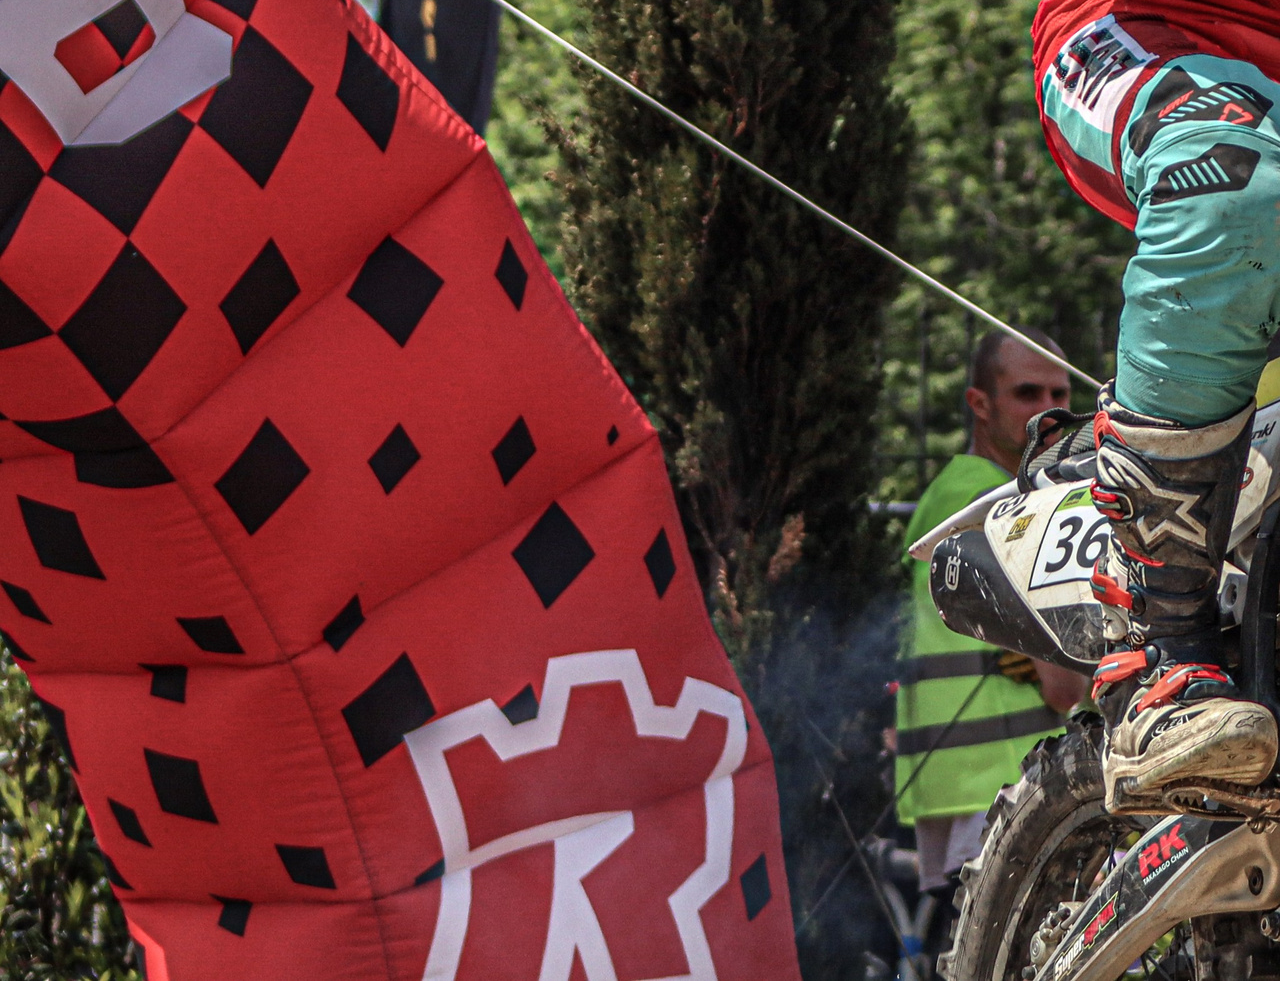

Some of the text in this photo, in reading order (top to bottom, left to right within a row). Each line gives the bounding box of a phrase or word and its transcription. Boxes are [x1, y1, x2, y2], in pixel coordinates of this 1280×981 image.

[1137, 822, 1188, 879] RK
[1142, 847, 1190, 886] TAKASAGO CHAIN
[1054, 934, 1085, 979] Super
